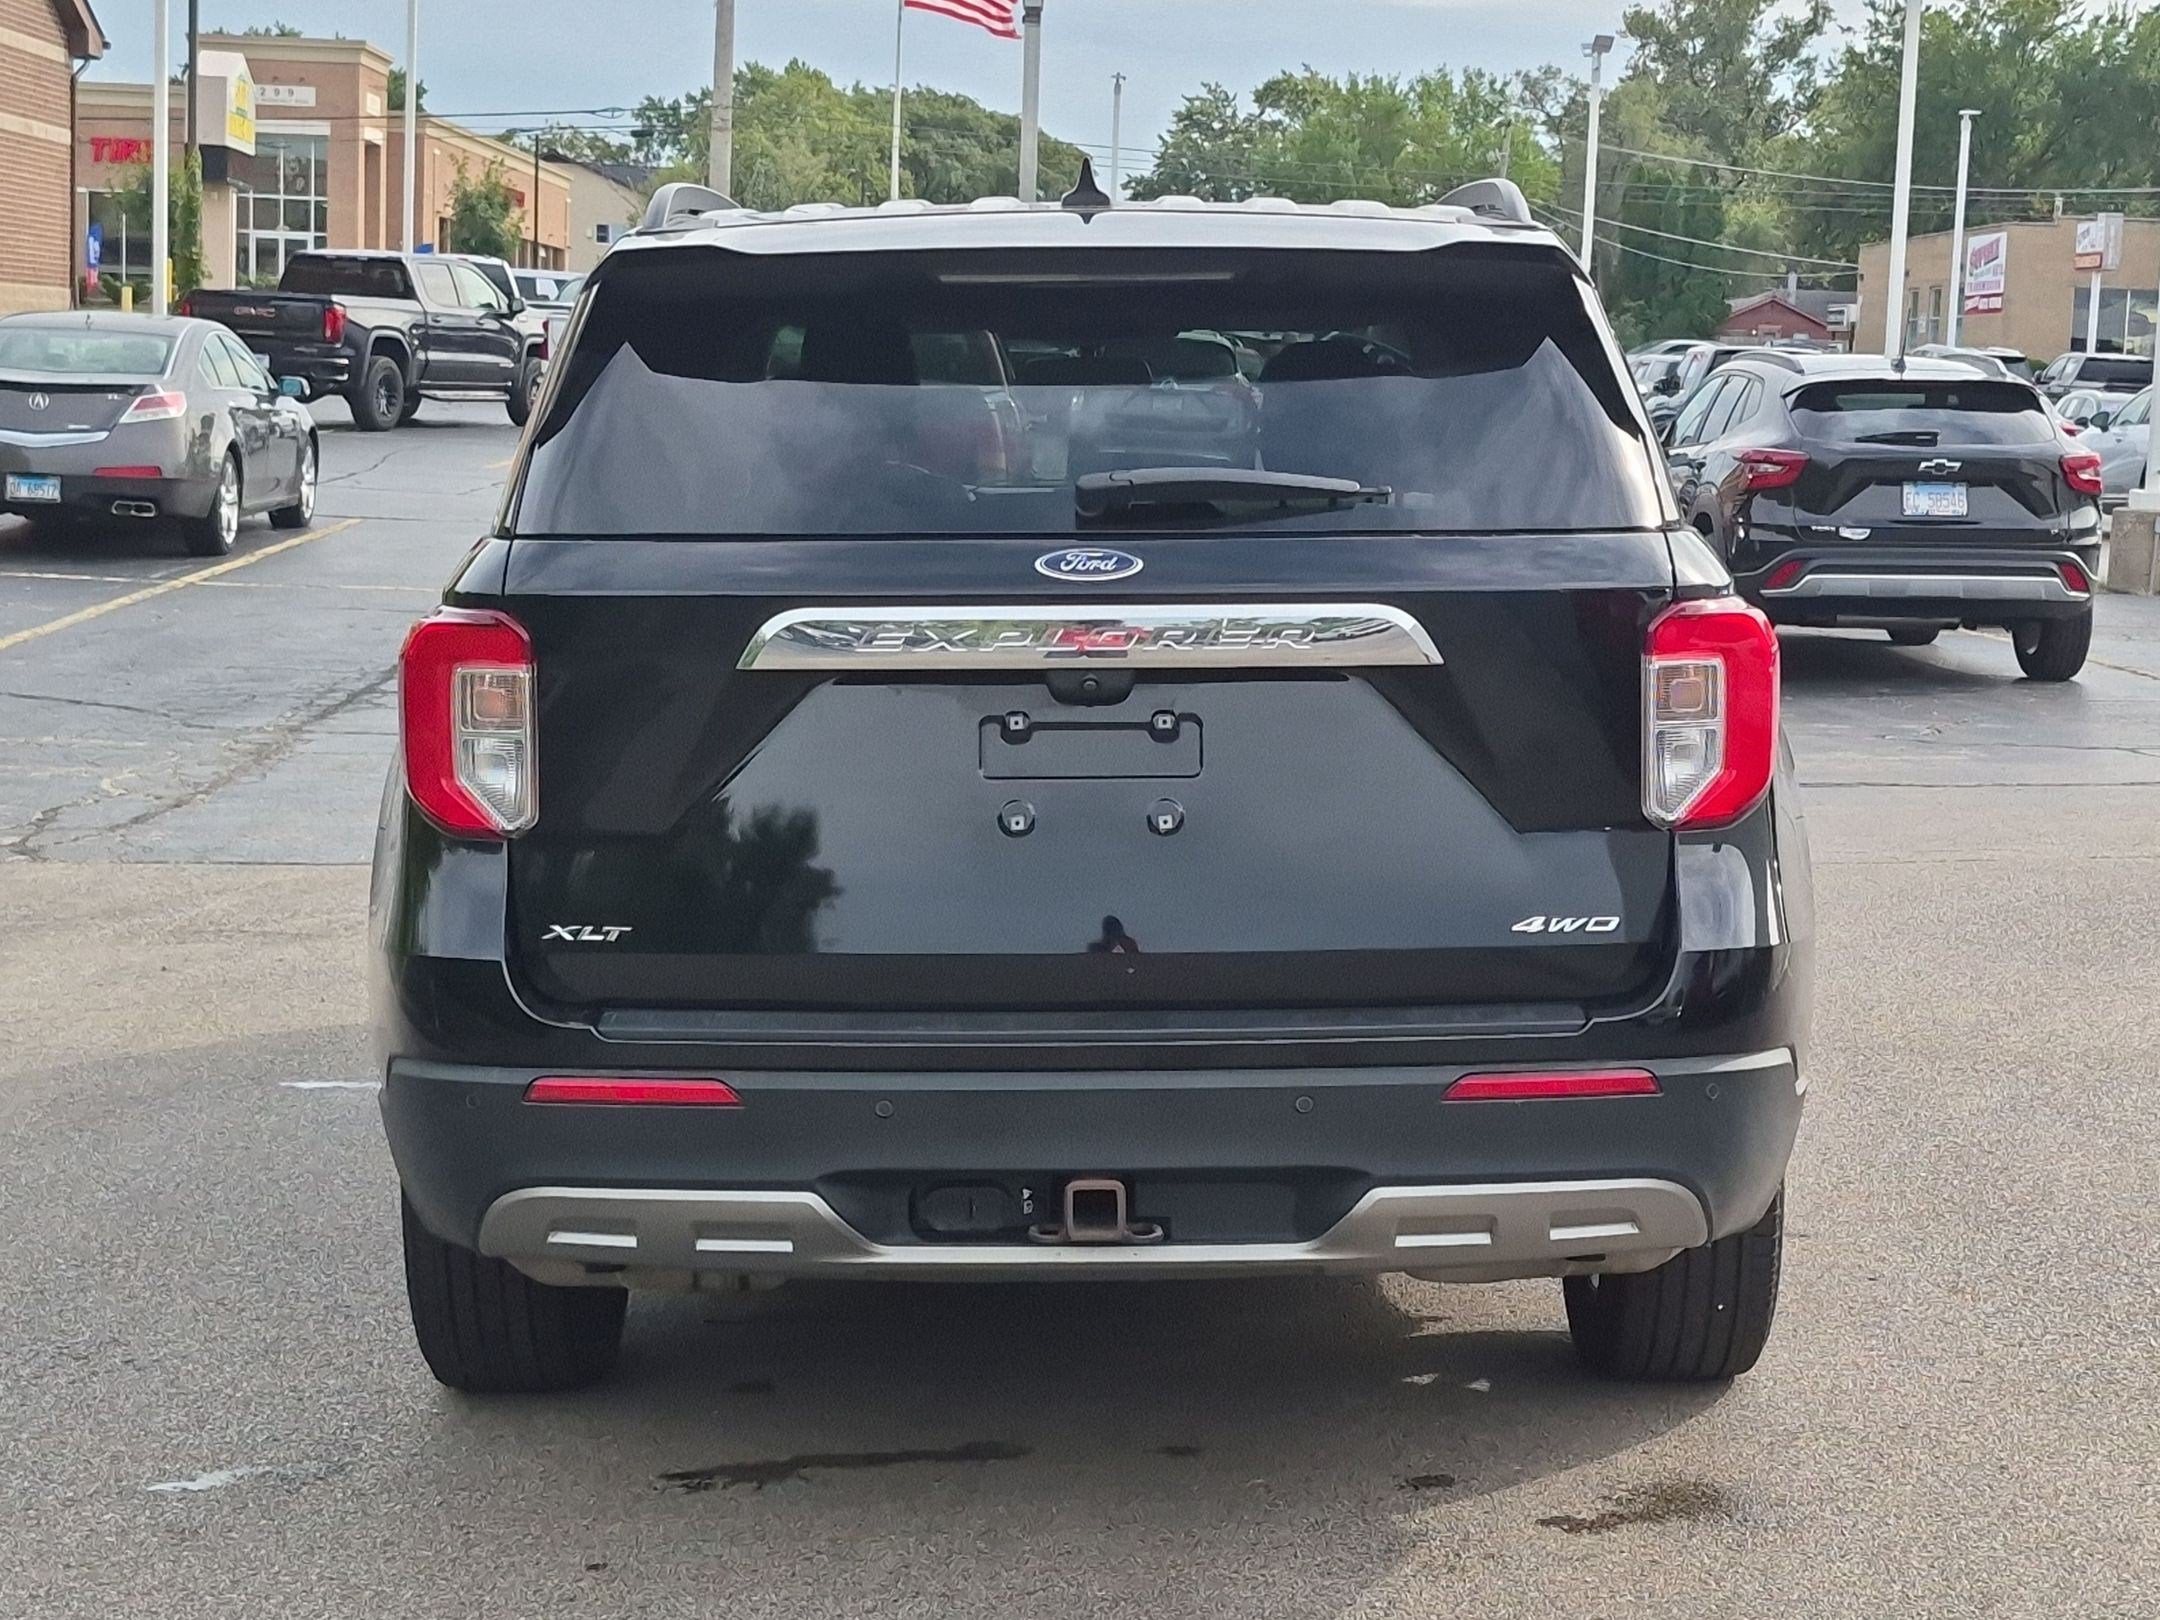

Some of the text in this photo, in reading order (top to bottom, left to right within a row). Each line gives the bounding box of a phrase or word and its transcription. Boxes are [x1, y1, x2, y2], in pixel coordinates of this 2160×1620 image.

[1060, 552, 1119, 571] Ford
[853, 627, 1315, 652] EXPLORER
[541, 924, 633, 942] XLT
[1511, 916, 1620, 933] 4WD
